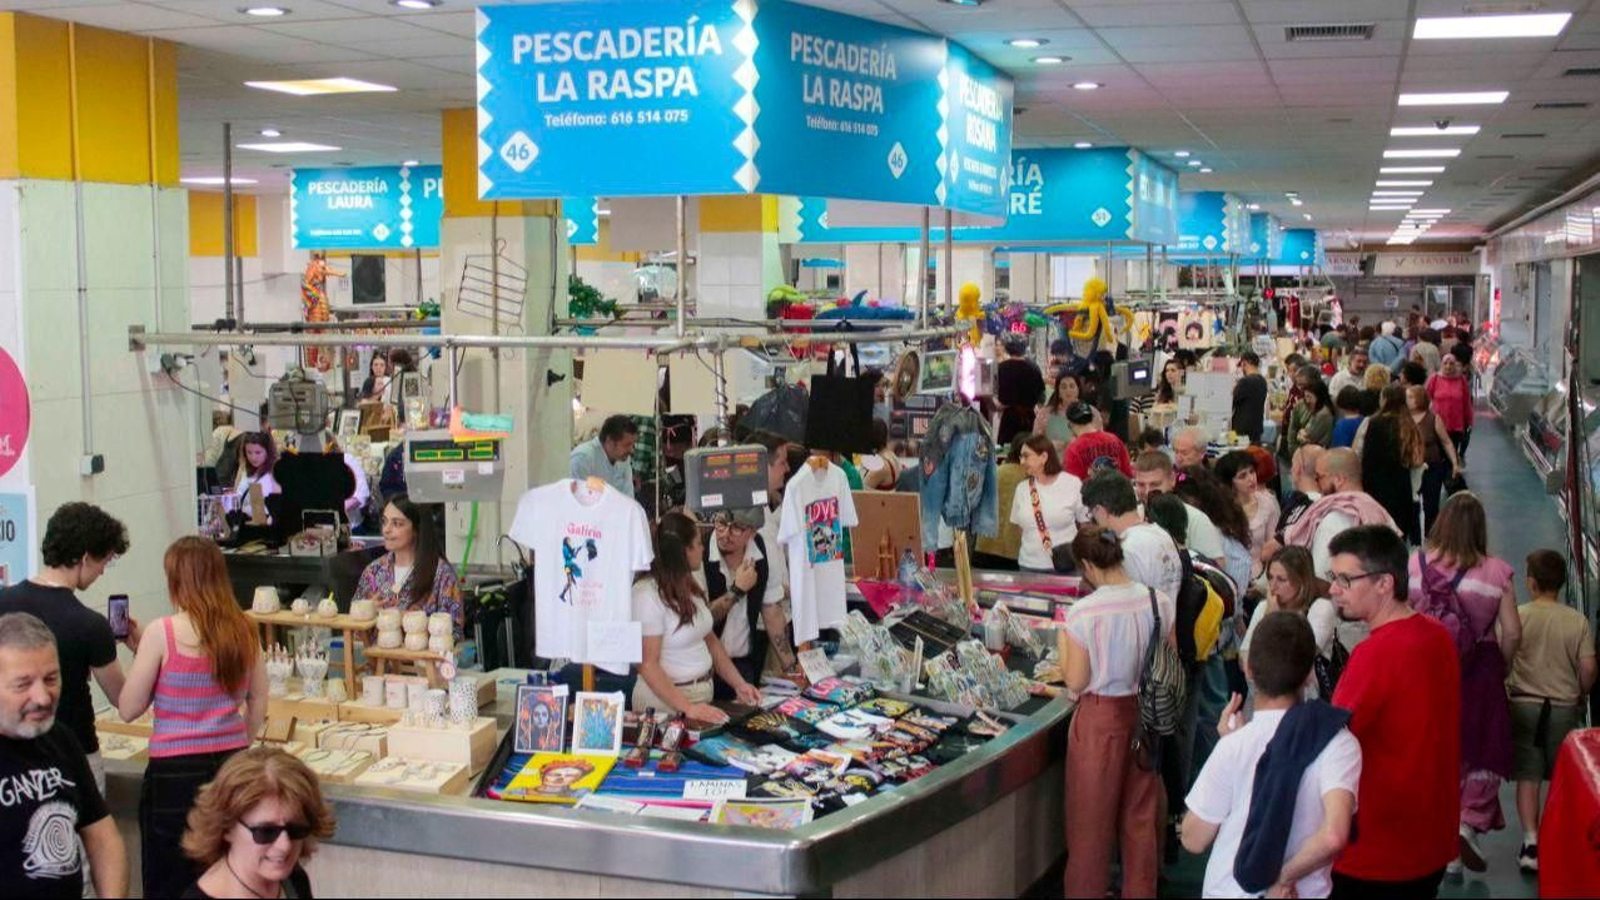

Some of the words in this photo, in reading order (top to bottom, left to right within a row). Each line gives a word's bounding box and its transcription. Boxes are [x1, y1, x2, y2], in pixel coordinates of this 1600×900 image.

[512, 15, 722, 64] PESCADERÍA
[791, 32, 896, 80] PESCADERÍA
[537, 71, 578, 103] LA
[588, 66, 698, 100] RASPA
[803, 74, 824, 105] LA
[830, 78, 883, 114] RASPA
[545, 112, 607, 127] Teléfono:
[611, 111, 633, 125] 616
[637, 110, 661, 124] 514
[664, 109, 688, 123] 075
[806, 115, 839, 131] Teléfono:
[506, 143, 530, 161] 46
[890, 153, 904, 168] 46
[308, 177, 389, 195] PESCADERÍA
[328, 195, 374, 210] LAURA
[808, 499, 838, 523] LOVE
[566, 522, 602, 539] Galicia
